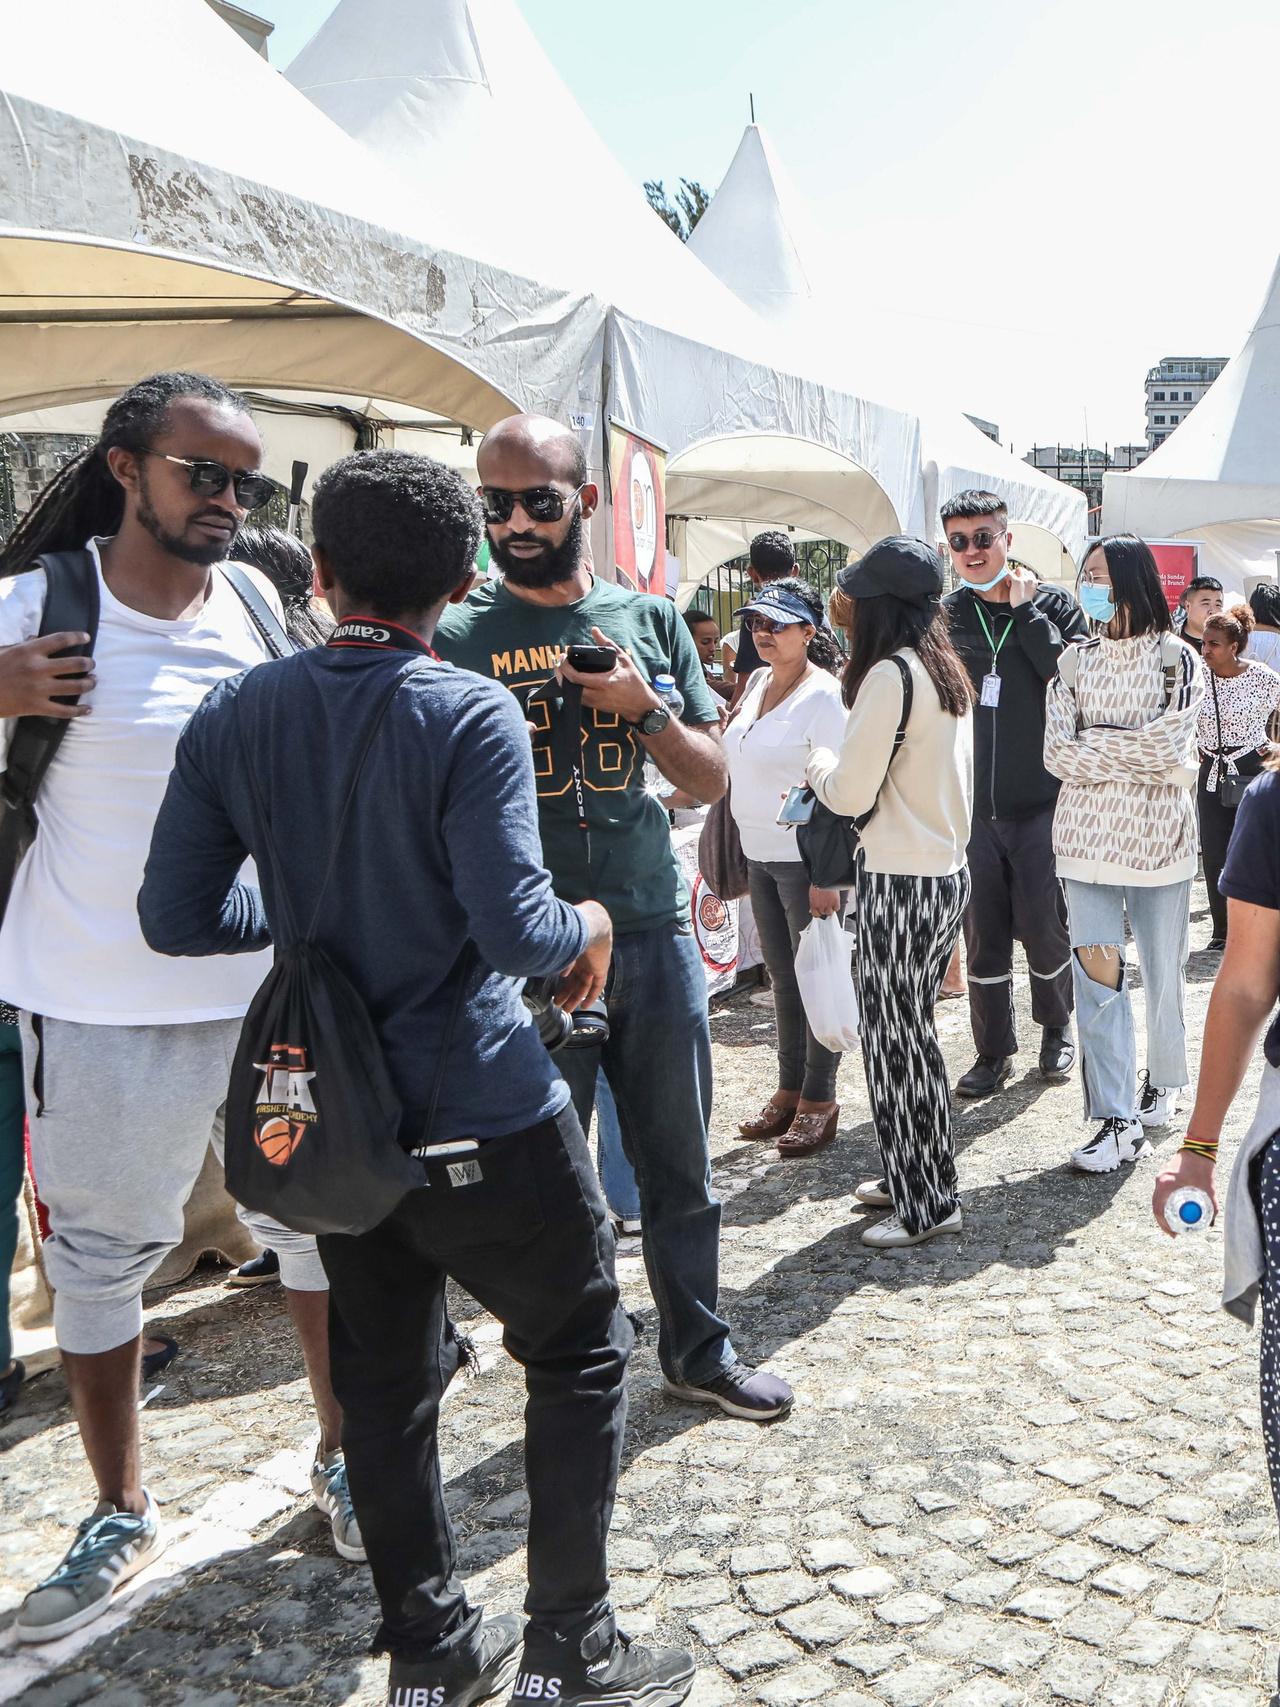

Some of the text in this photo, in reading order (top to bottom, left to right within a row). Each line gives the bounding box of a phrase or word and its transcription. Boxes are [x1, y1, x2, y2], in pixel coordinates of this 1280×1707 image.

[572, 416, 585, 427] 140
[333, 624, 390, 642] Canon
[491, 645, 570, 677] MANH
[572, 764, 585, 817] SONY
